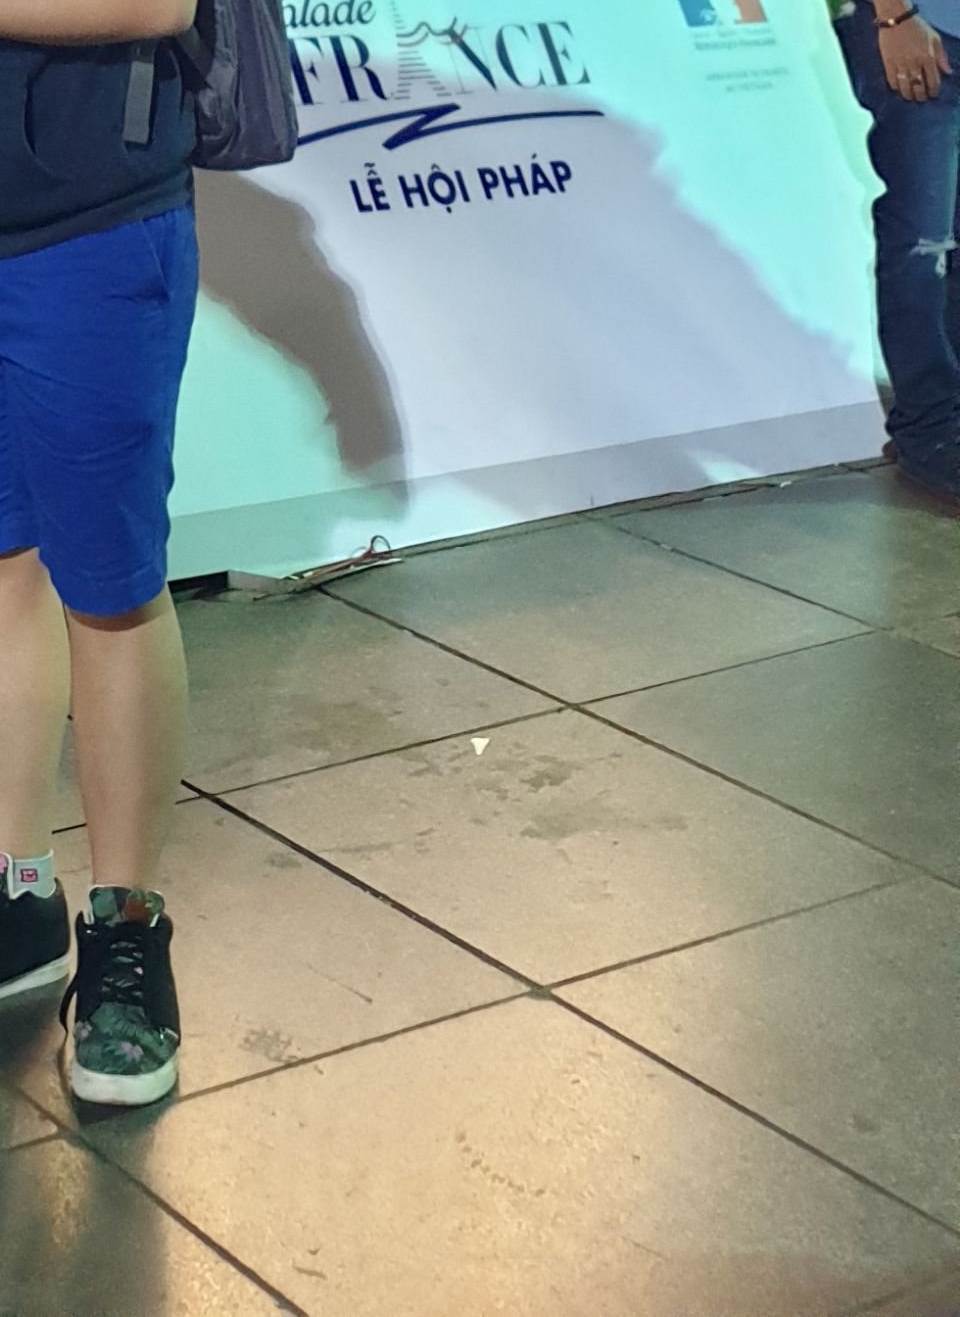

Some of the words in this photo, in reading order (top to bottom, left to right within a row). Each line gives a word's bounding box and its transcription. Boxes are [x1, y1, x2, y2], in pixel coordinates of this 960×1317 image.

[349, 162, 391, 213] LỄ
[398, 163, 470, 214] HỘI
[477, 153, 572, 200] PHÁP
